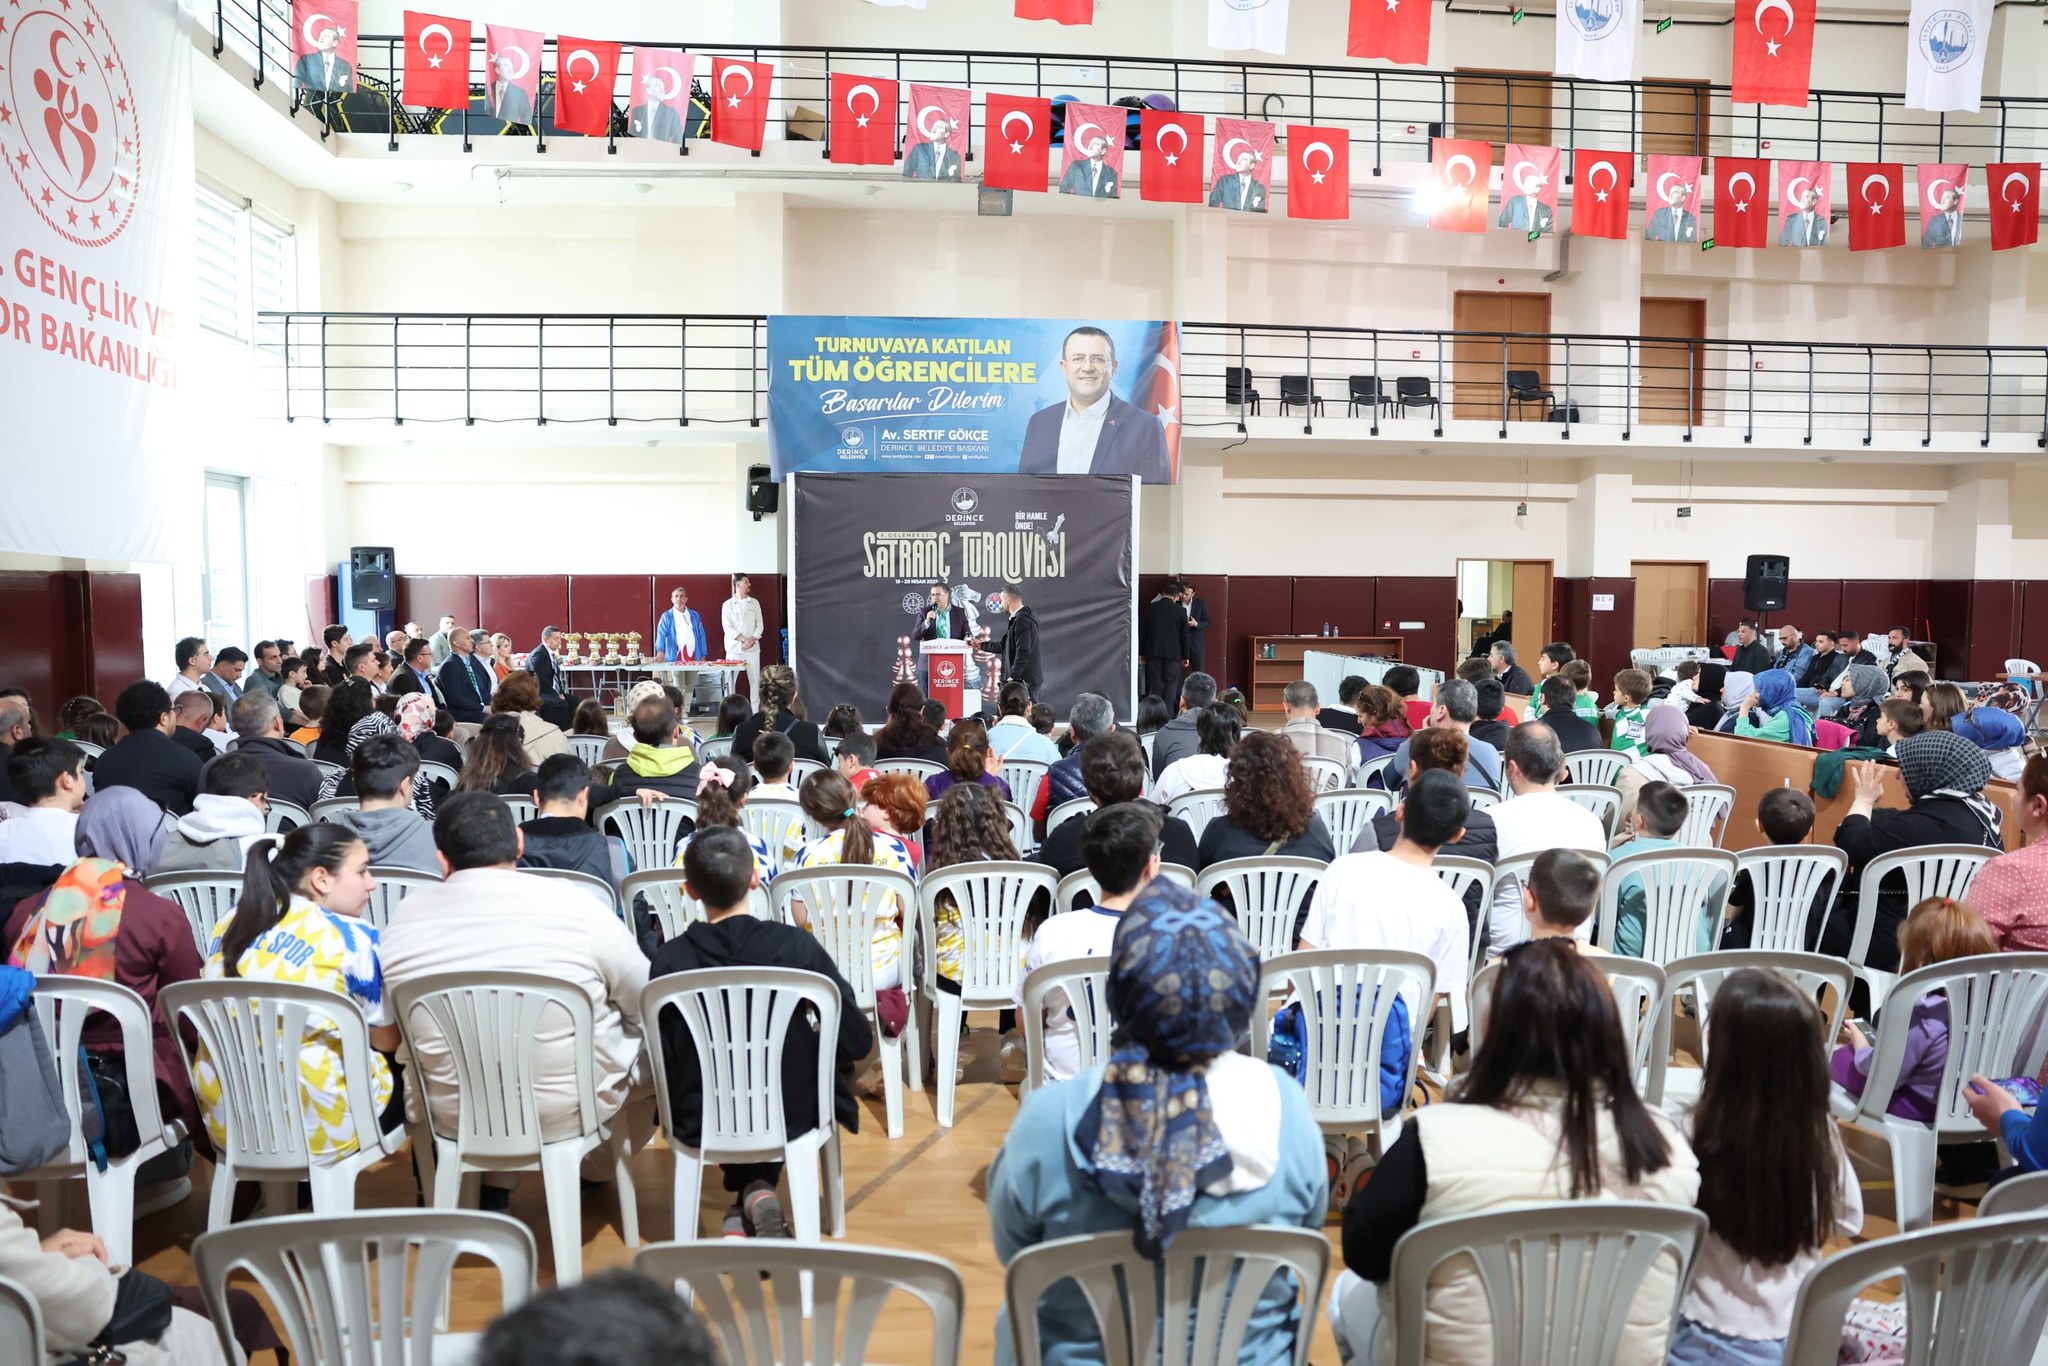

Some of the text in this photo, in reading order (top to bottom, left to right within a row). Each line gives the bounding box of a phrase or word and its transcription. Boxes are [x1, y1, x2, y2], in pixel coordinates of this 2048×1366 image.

[14, 248, 175, 341] GENÇLİK VE
[41, 312, 177, 390] BAKANLIĞI
[814, 336, 1011, 355] TURNUVAYA KATILAN
[789, 355, 1037, 384] TÜM ÖĞRENCİLERE
[820, 386, 1006, 415] Başarılar Dilerim
[881, 429, 900, 440] Av.
[948, 428, 989, 442] GÖKÇE
[957, 444, 989, 453] BAŞKANI
[1015, 510, 1048, 520] BİR HAMLE
[1015, 521, 1034, 530] ÖNDE!
[863, 531, 951, 584] SATRANÇ
[267, 931, 314, 968] SPOR
